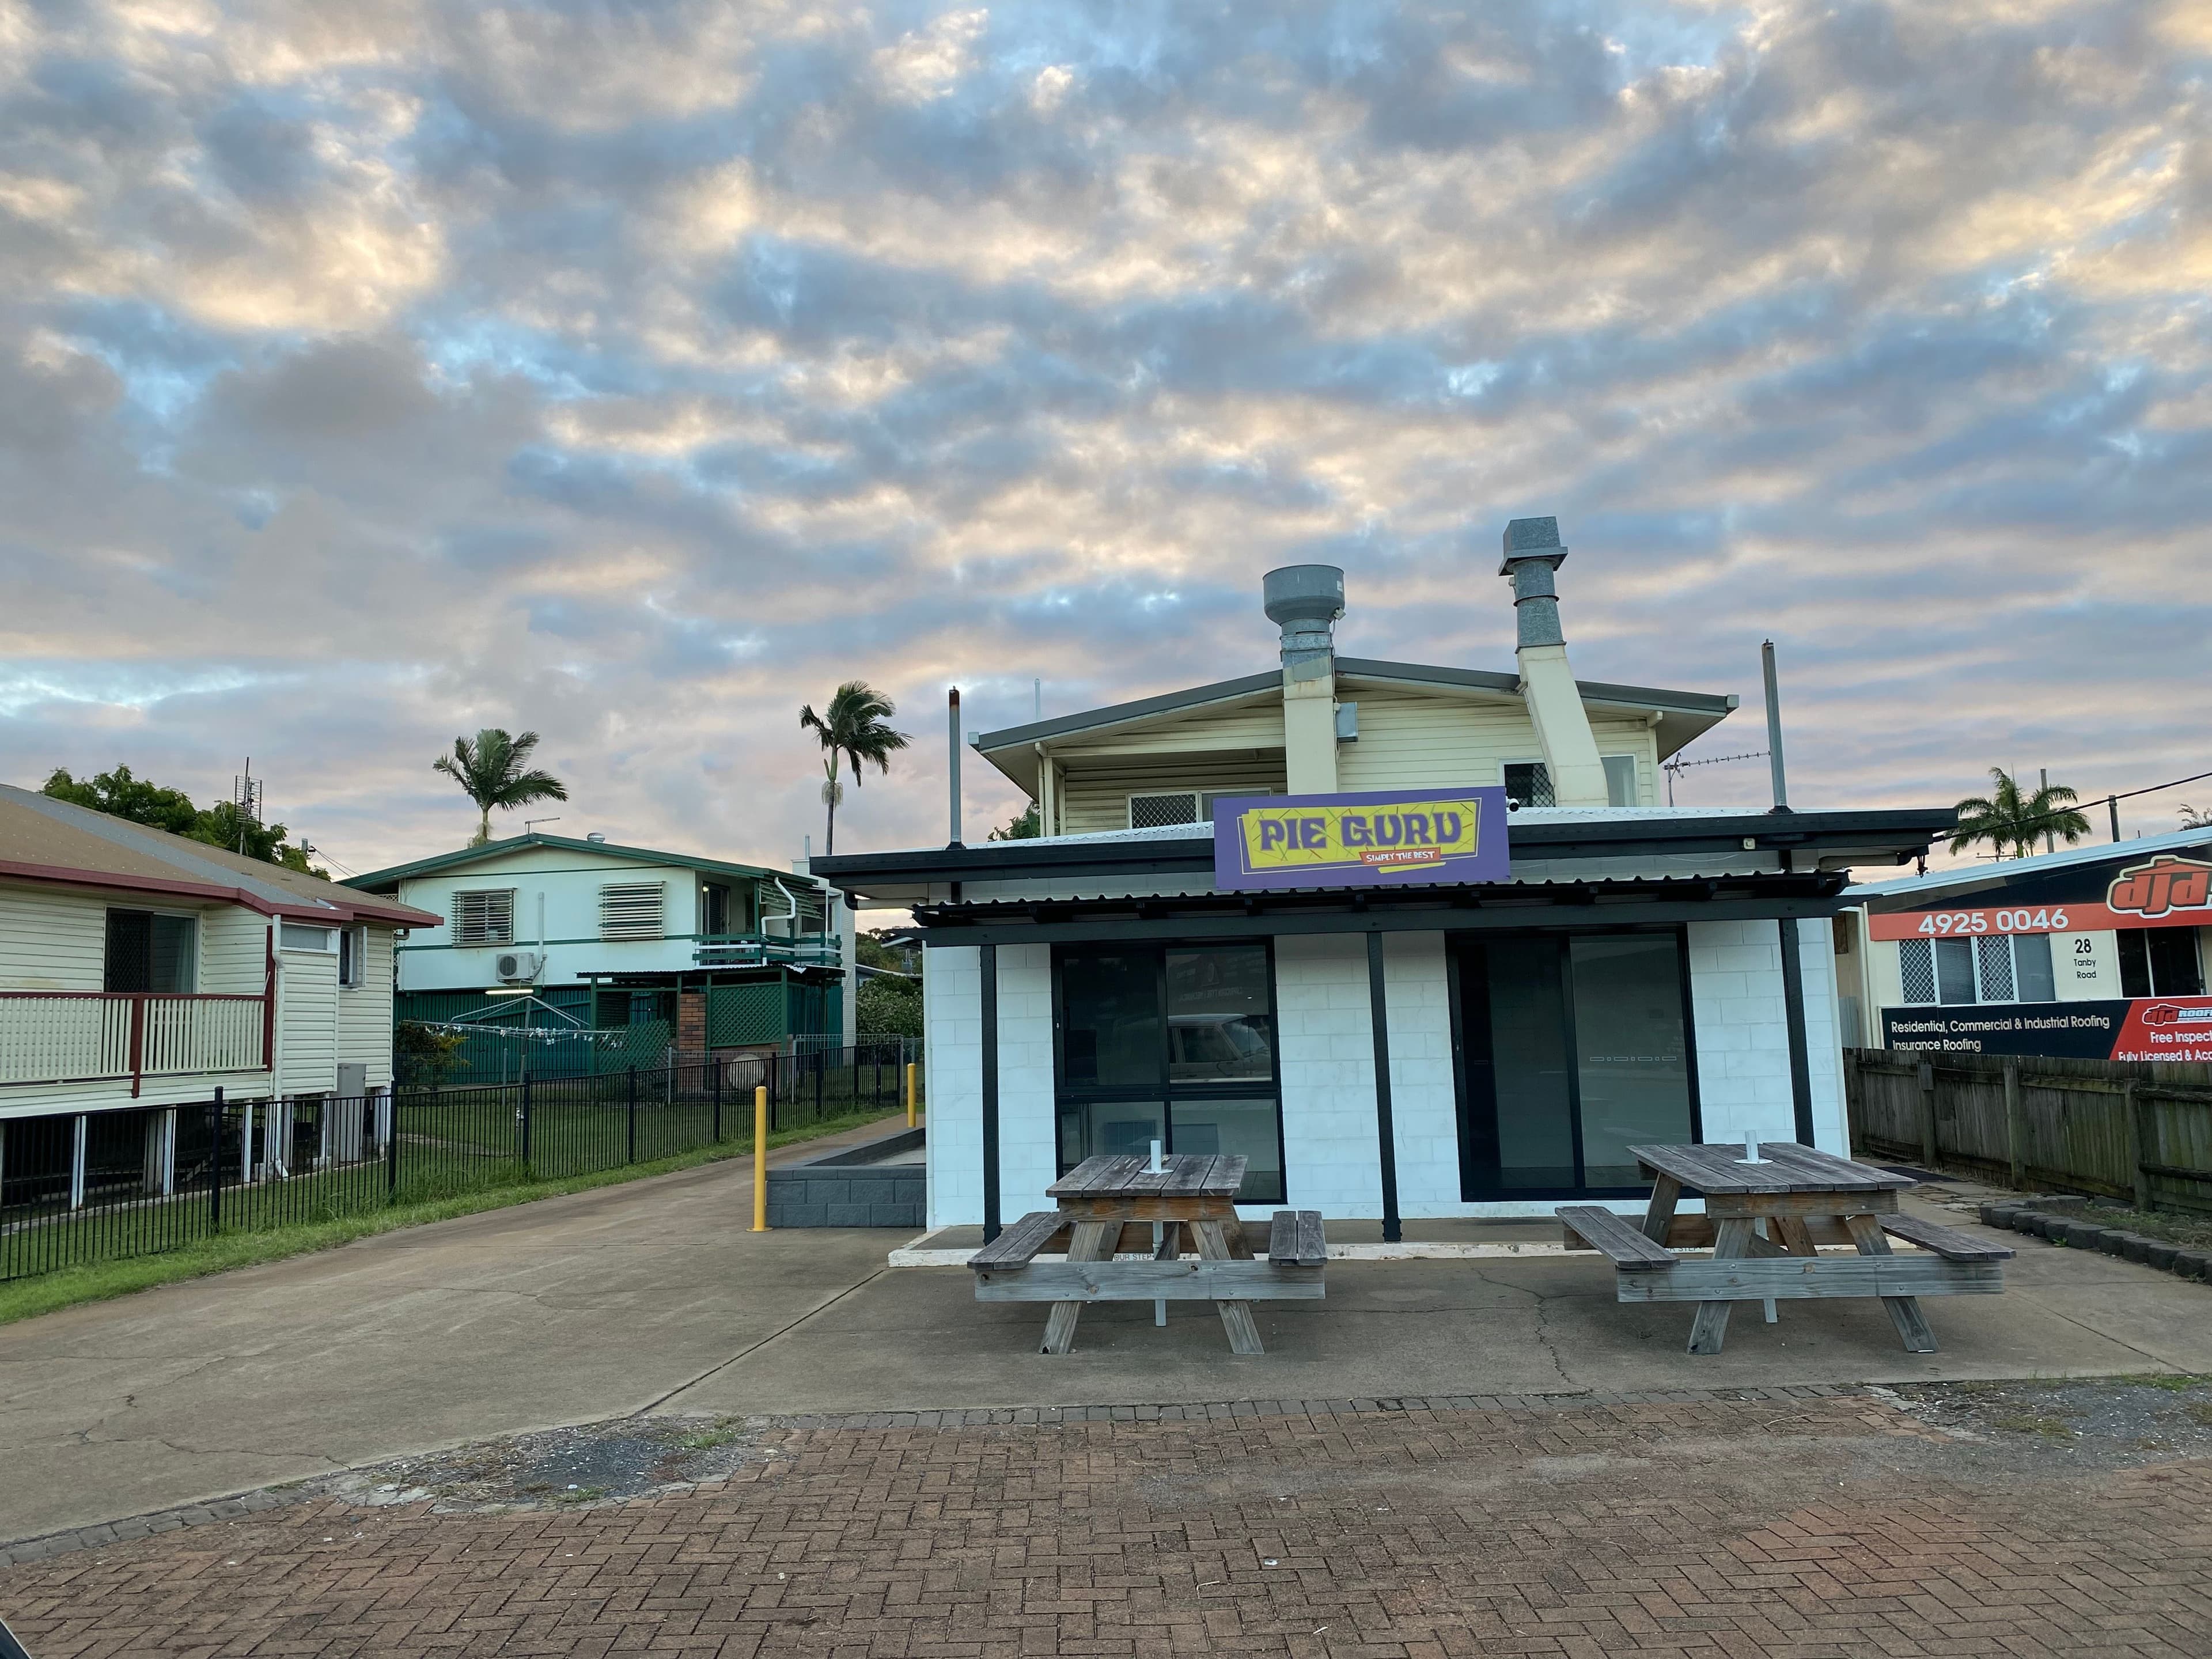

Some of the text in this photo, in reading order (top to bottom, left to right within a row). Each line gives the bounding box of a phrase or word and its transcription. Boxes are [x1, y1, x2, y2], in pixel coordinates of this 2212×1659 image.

[1260, 812, 1463, 851] PIE GURU
[1366, 851, 1435, 862] SIMPLY THE BEST
[1918, 908, 2069, 934] 4925 0046
[2075, 938, 2092, 953] 28
[2074, 958, 2097, 968] Tanby
[2077, 970, 2097, 979] Road
[1891, 1014, 2110, 1033] Residential, Commercial & Industrial Roofing
[2150, 1031, 2173, 1043] Free
[1892, 1038, 1982, 1052] Insurance Roofing
[2140, 1049, 2183, 1062] Licensed
[2184, 1049, 2192, 1061] &
